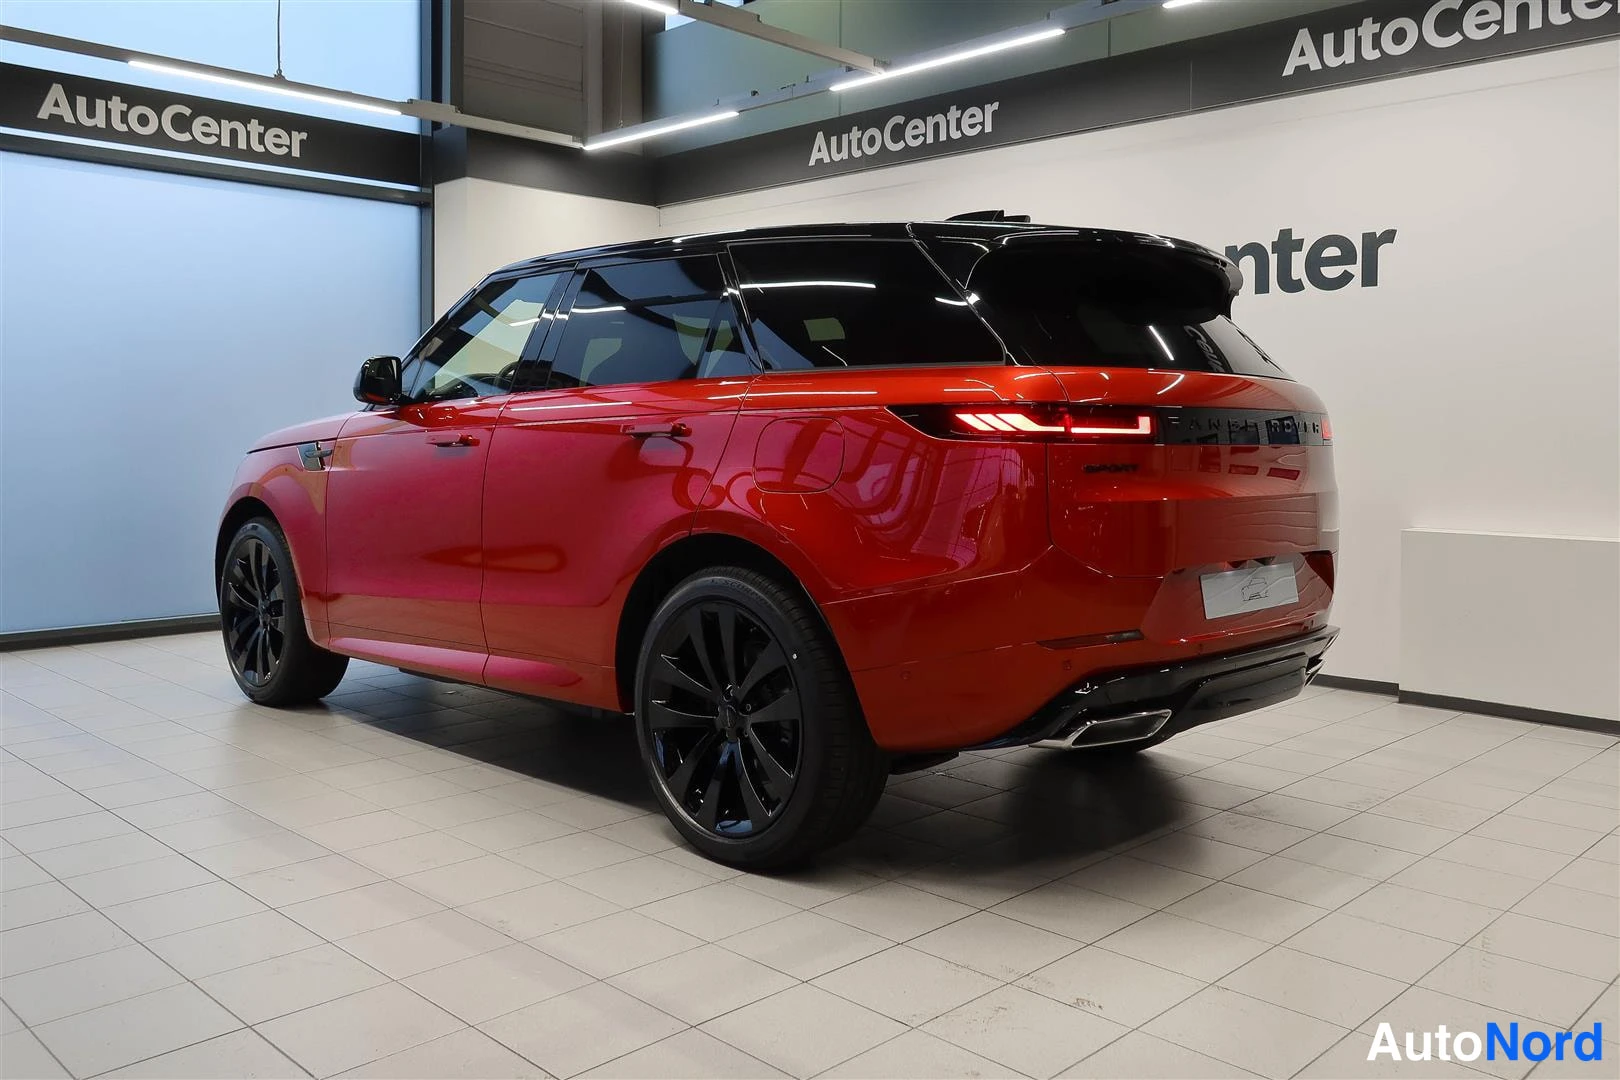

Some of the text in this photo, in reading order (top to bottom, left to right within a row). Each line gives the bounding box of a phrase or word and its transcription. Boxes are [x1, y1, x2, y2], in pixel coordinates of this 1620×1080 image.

[1281, 0, 1620, 77] AutoCent
[36, 82, 308, 158] AutoCenter
[808, 101, 1000, 167] AutoCenter
